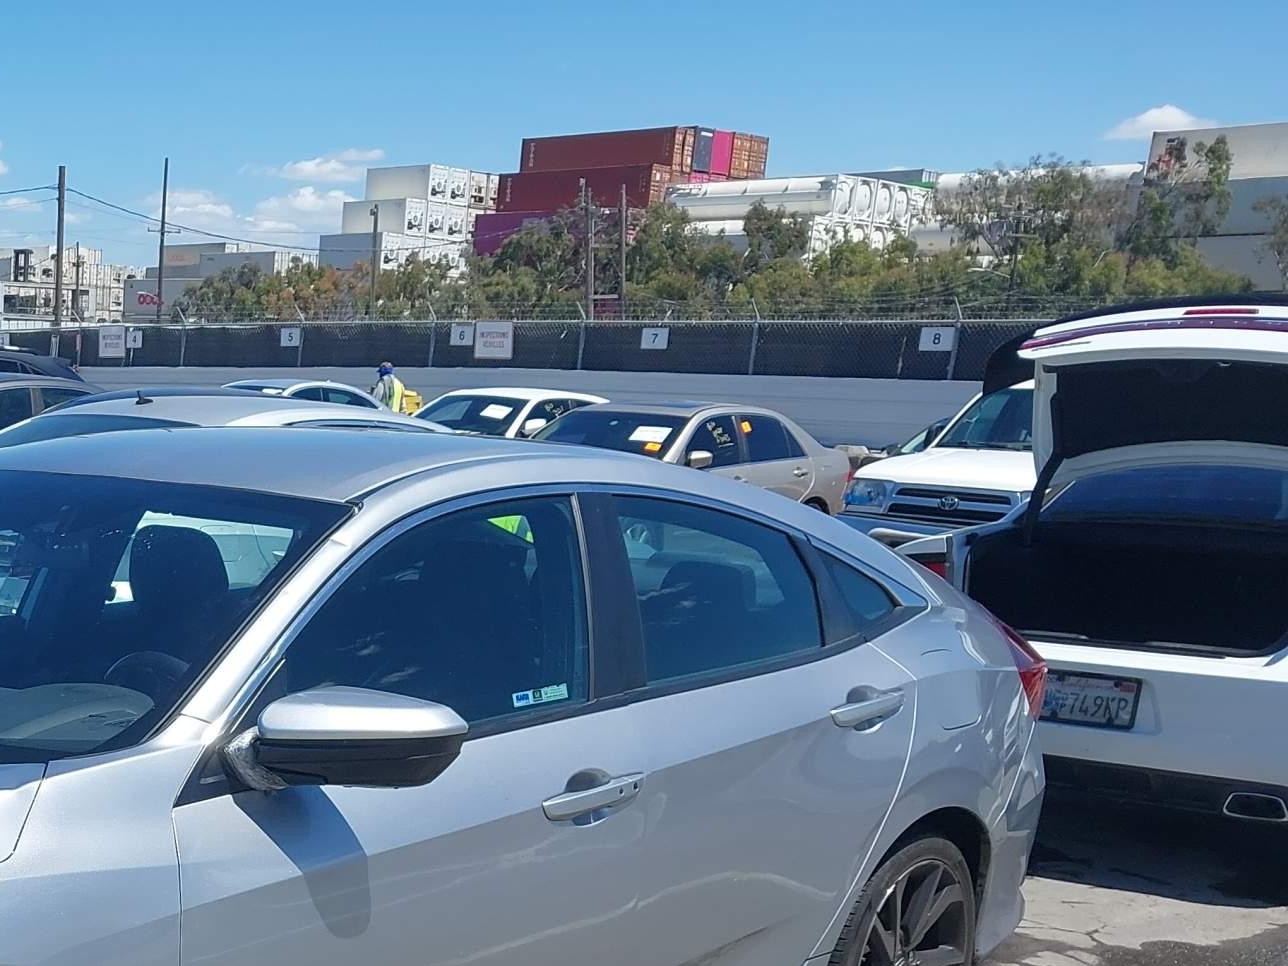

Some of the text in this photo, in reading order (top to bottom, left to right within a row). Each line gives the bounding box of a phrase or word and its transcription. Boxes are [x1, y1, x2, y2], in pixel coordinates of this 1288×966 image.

[131, 335, 138, 344] 4
[287, 332, 294, 342] 5
[458, 330, 465, 341] 6
[650, 333, 659, 344] 7
[932, 332, 941, 345] 8
